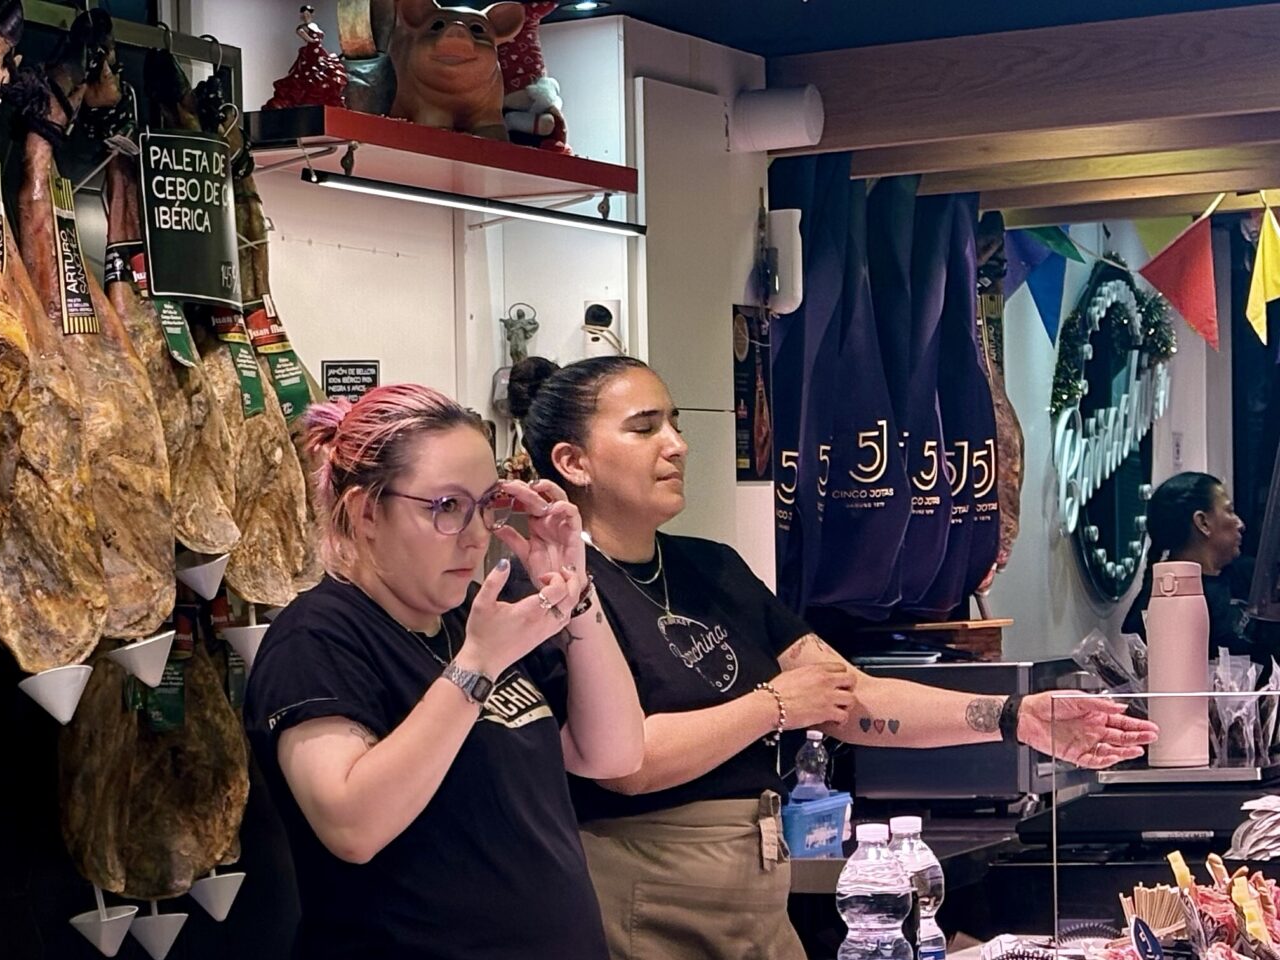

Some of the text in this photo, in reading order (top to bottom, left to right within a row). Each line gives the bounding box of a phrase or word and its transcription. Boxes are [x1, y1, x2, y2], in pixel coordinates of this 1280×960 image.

[150, 146, 226, 178] PALETA DE
[152, 177, 200, 201] CEBO
[204, 182, 220, 206] DE
[155, 201, 211, 233] IBÉRICA
[60, 230, 79, 293] ARTURO
[849, 420, 887, 483] 5J
[972, 439, 995, 498] 5J
[832, 487, 894, 500] CINCO JOTAS
